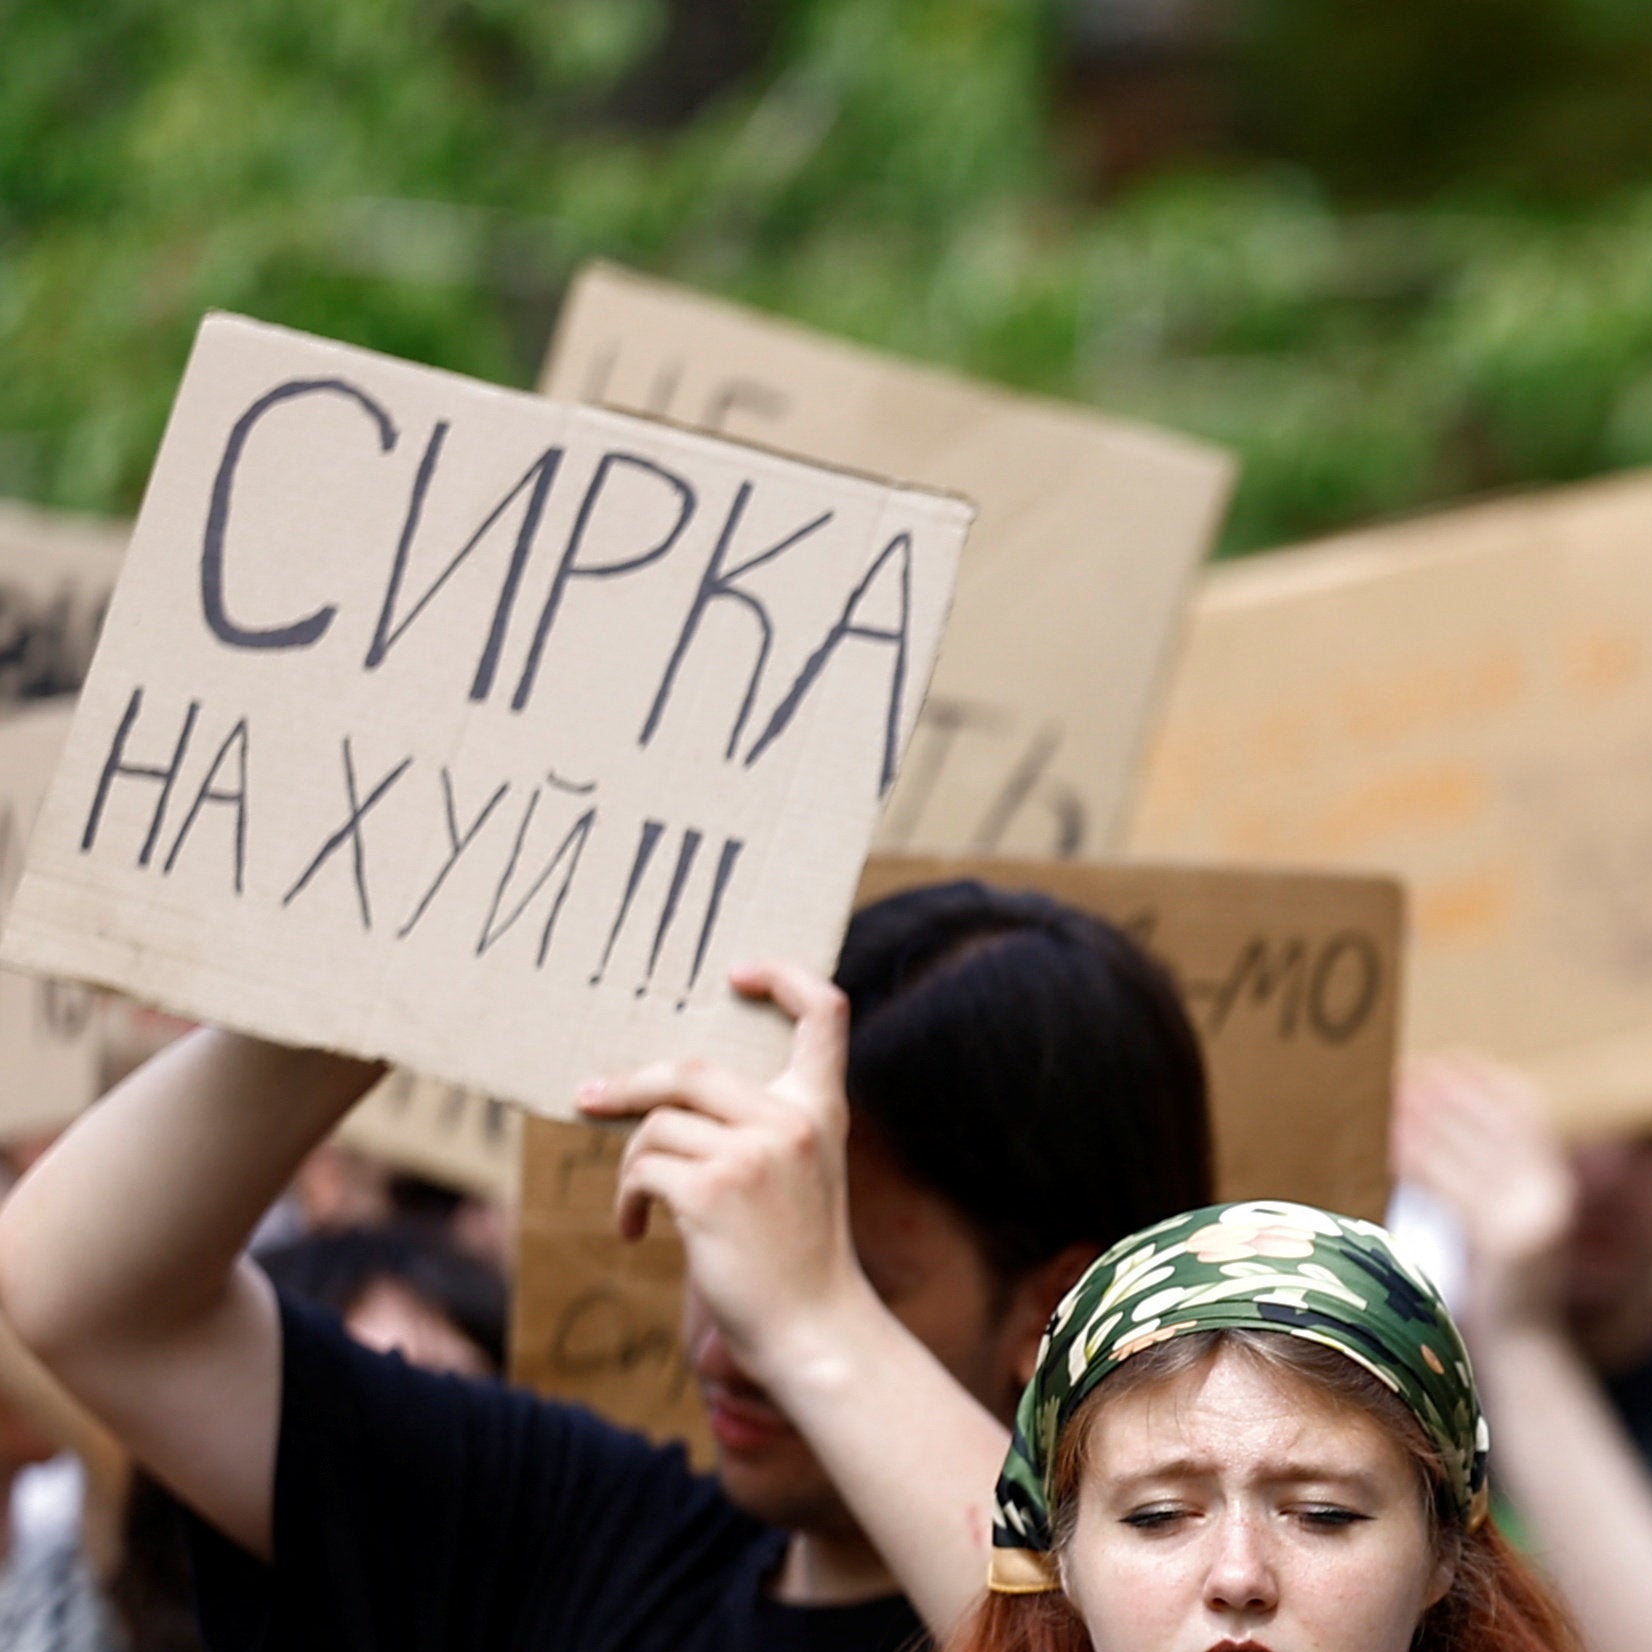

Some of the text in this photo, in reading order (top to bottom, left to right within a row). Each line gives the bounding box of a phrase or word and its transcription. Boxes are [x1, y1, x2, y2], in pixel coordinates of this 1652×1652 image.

[199, 377, 914, 798] СИРКА
[80, 686, 250, 898] НА
[281, 736, 747, 1012] ХУЙ!!!
